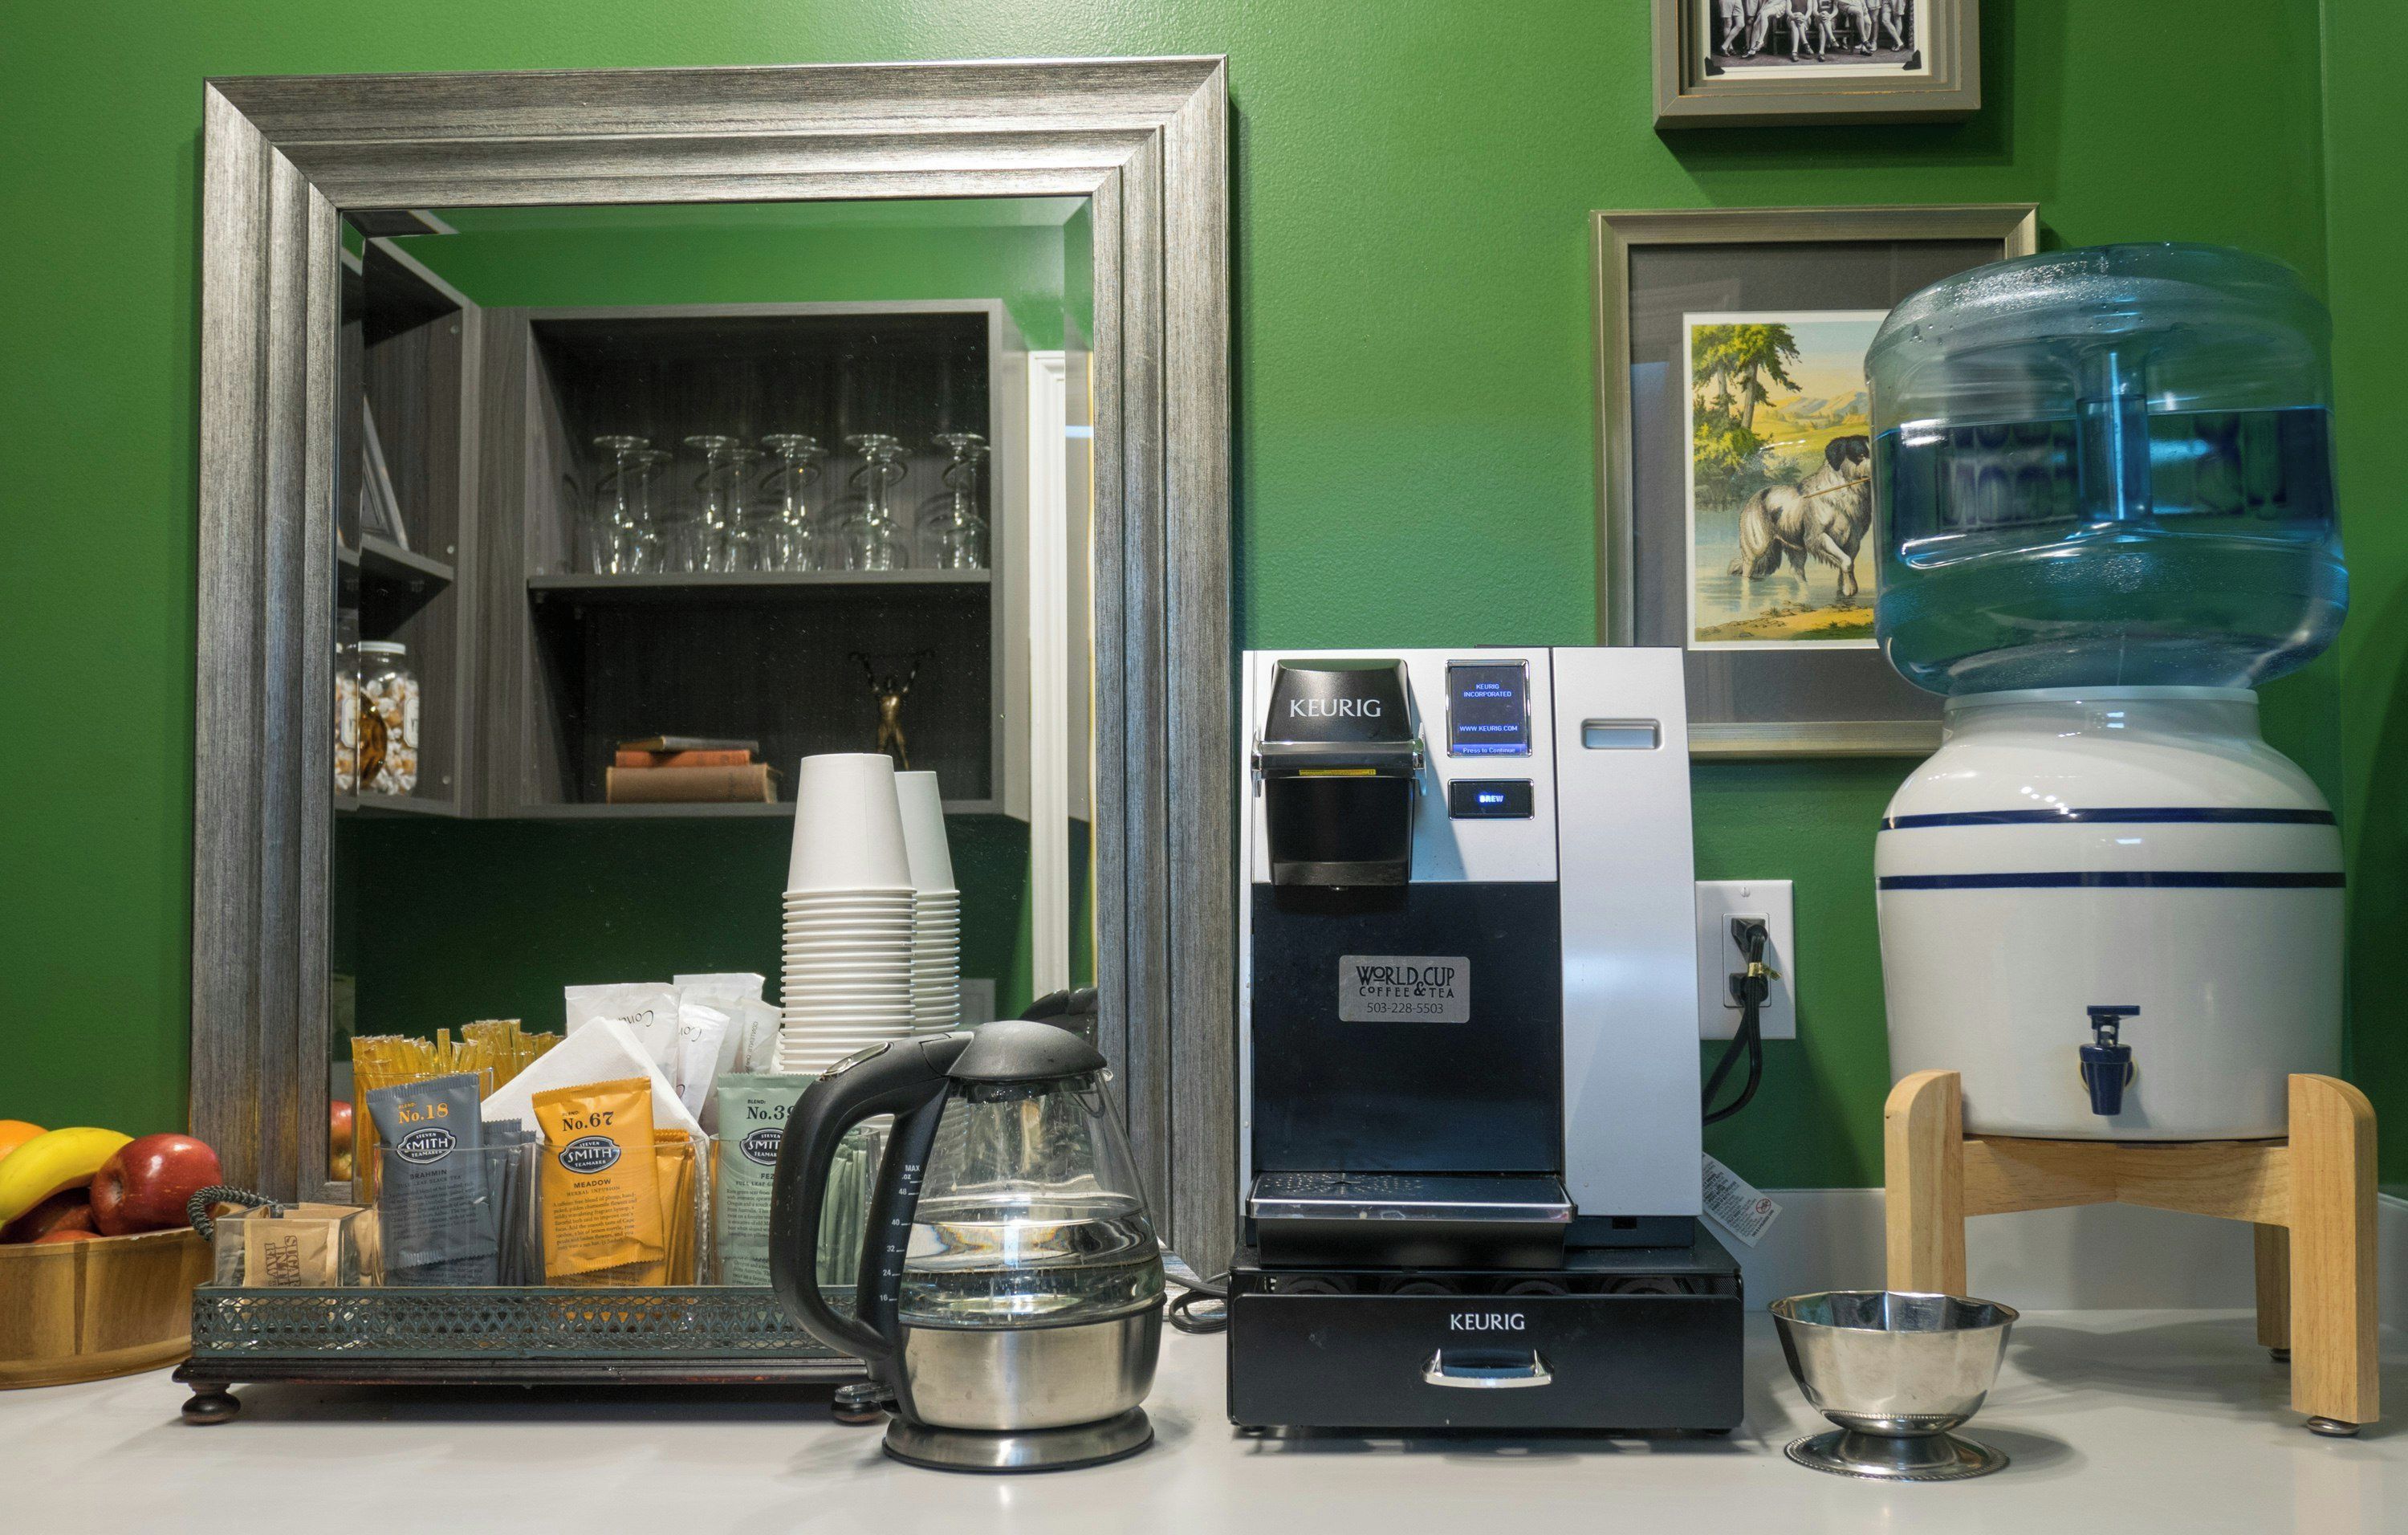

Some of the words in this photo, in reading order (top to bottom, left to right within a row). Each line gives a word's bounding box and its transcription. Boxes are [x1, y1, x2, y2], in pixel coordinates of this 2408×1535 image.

[1289, 698, 1381, 718] KEURIG
[1479, 795, 1504, 803] BREW
[1355, 966, 1419, 986] WORLD
[1423, 967, 1454, 987] CUP
[1359, 986, 1409, 998] COFFEE
[1413, 981, 1426, 997] &
[1429, 987, 1454, 998] TEA
[1366, 1002, 1444, 1014] 503-228-5503
[398, 1102, 449, 1124] No.18
[562, 1111, 614, 1132] No.67
[405, 1138, 449, 1153] SMITH
[748, 1140, 780, 1150] SMIT
[567, 1148, 612, 1162] SMITH
[575, 1159, 606, 1167] TEAMAKER
[409, 1169, 447, 1179] BRAHMIN
[573, 1179, 612, 1188] MEADOW
[1450, 1313, 1525, 1330] KEURIG
